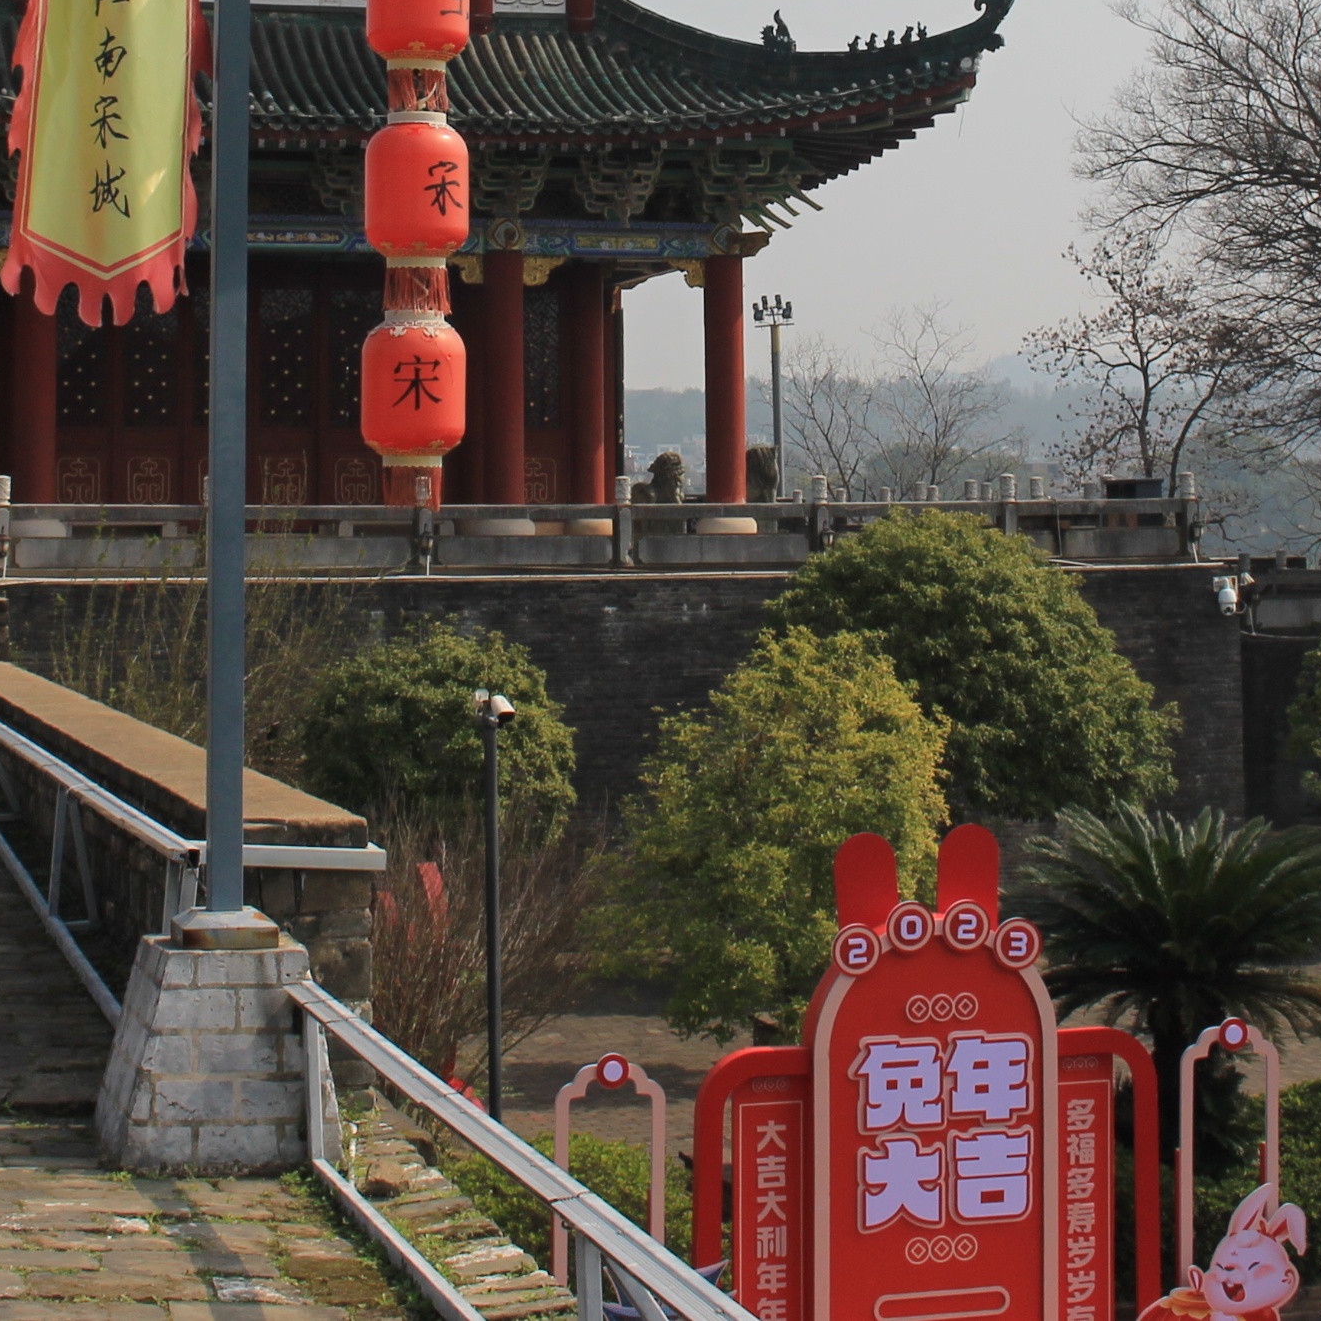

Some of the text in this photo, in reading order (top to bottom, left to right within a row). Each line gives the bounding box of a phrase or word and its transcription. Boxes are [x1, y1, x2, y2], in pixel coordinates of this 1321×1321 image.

[423, 160, 464, 217] 宋
[392, 354, 443, 411] 宋
[847, 913, 1029, 965] 2023
[856, 1037, 1028, 1129] 兔年
[864, 1133, 1030, 1227] 大吉
